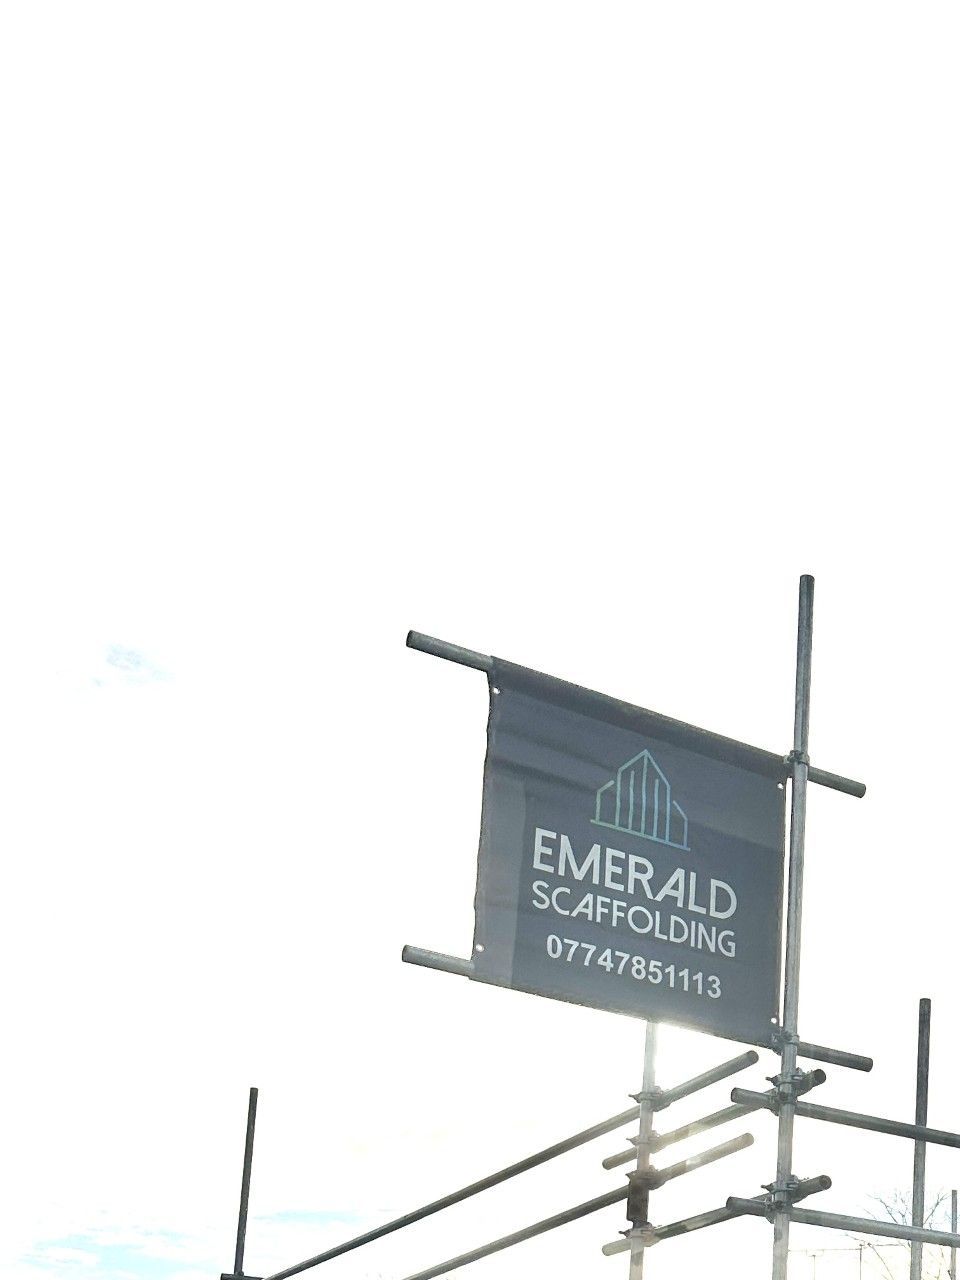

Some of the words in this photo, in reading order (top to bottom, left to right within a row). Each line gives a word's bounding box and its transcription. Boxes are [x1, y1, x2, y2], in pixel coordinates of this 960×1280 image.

[532, 827, 738, 920] EMERALD
[532, 880, 736, 958] SCAFFOLDING
[546, 934, 722, 999] 07747851113
